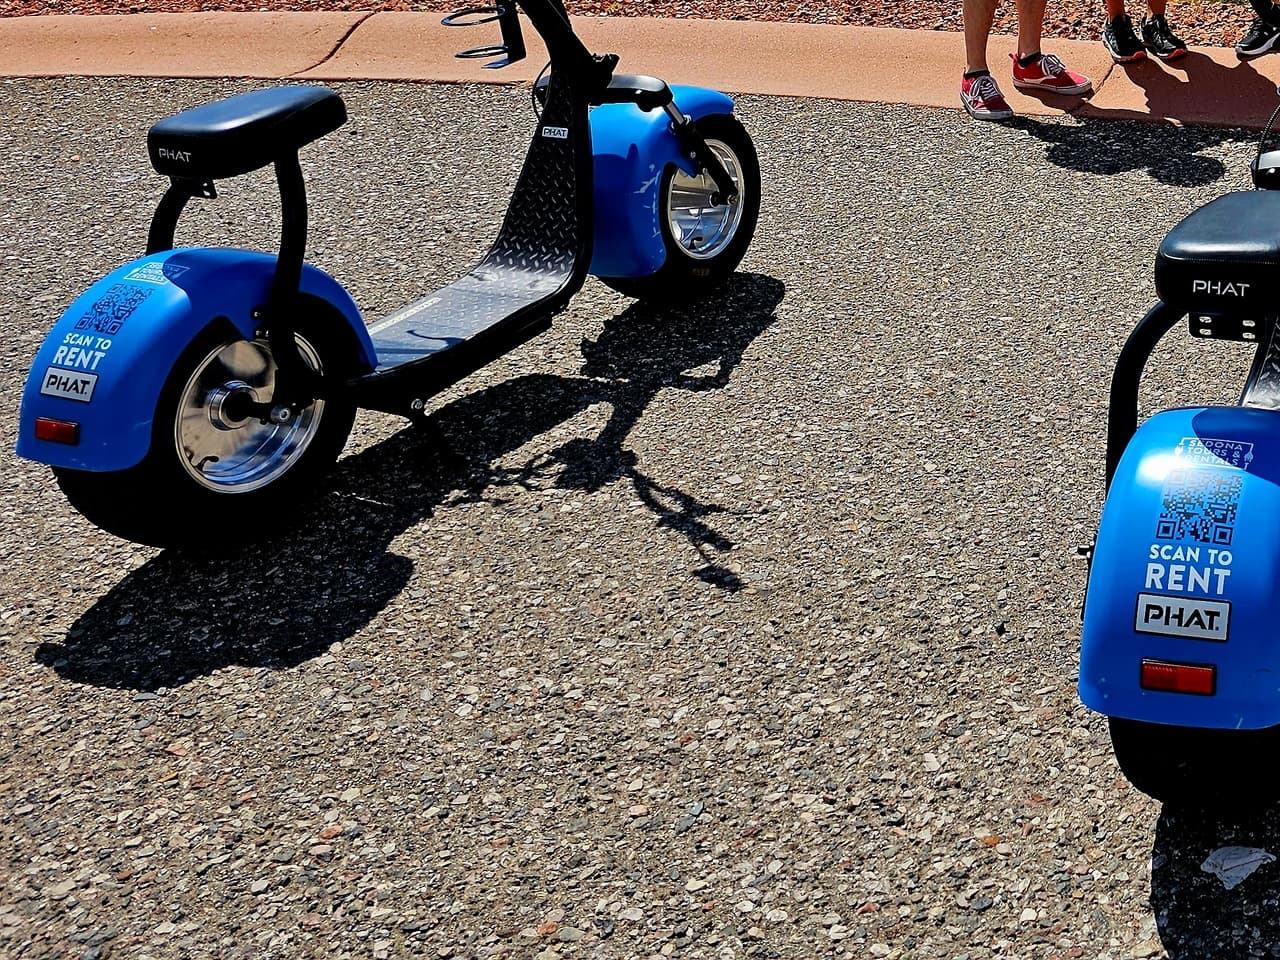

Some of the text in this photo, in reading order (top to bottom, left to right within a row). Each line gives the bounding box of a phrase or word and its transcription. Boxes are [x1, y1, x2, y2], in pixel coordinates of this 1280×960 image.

[543, 127, 567, 137] PHAT
[159, 148, 192, 162] PHAT
[1192, 280, 1250, 296] PHAT
[63, 333, 112, 350] SCAN TO
[52, 345, 106, 370] RENT
[1187, 446, 1241, 458] TOURS &
[1189, 439, 1243, 451] SEDONA
[1185, 454, 1239, 467] RENTALS
[1149, 544, 1233, 566] SCAN TO
[1145, 562, 1231, 594] RENT
